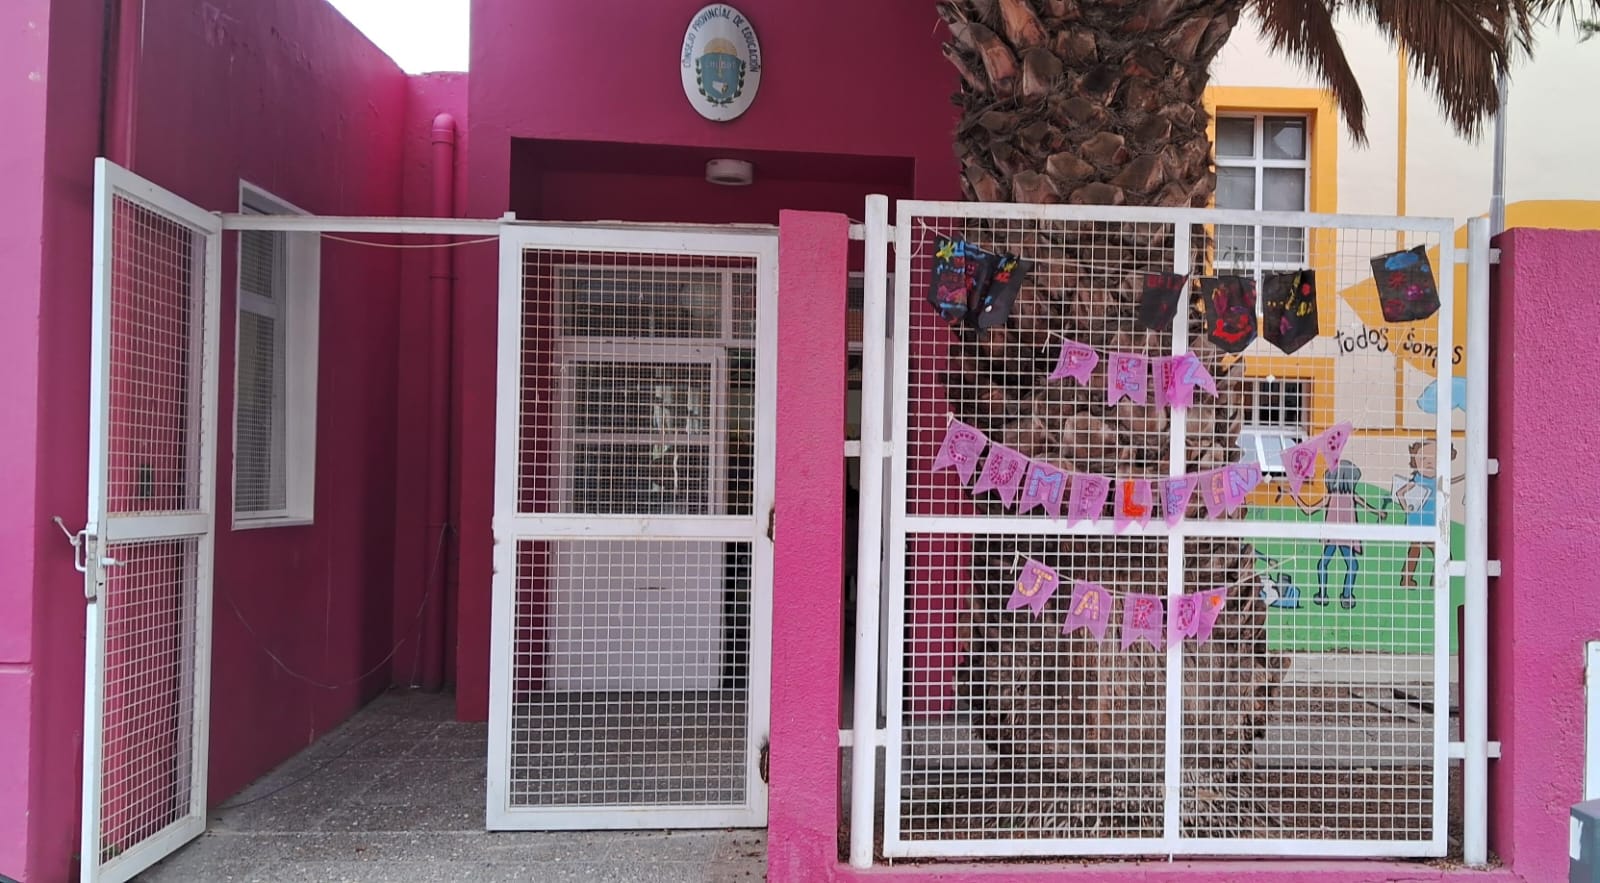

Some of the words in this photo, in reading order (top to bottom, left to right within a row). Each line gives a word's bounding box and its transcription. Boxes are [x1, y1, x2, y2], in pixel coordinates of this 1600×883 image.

[683, 33, 696, 68] CONSEJO
[694, 7, 731, 32] PROVINCIAL
[733, 15, 744, 27] DE
[1403, 328, 1463, 368] soms
